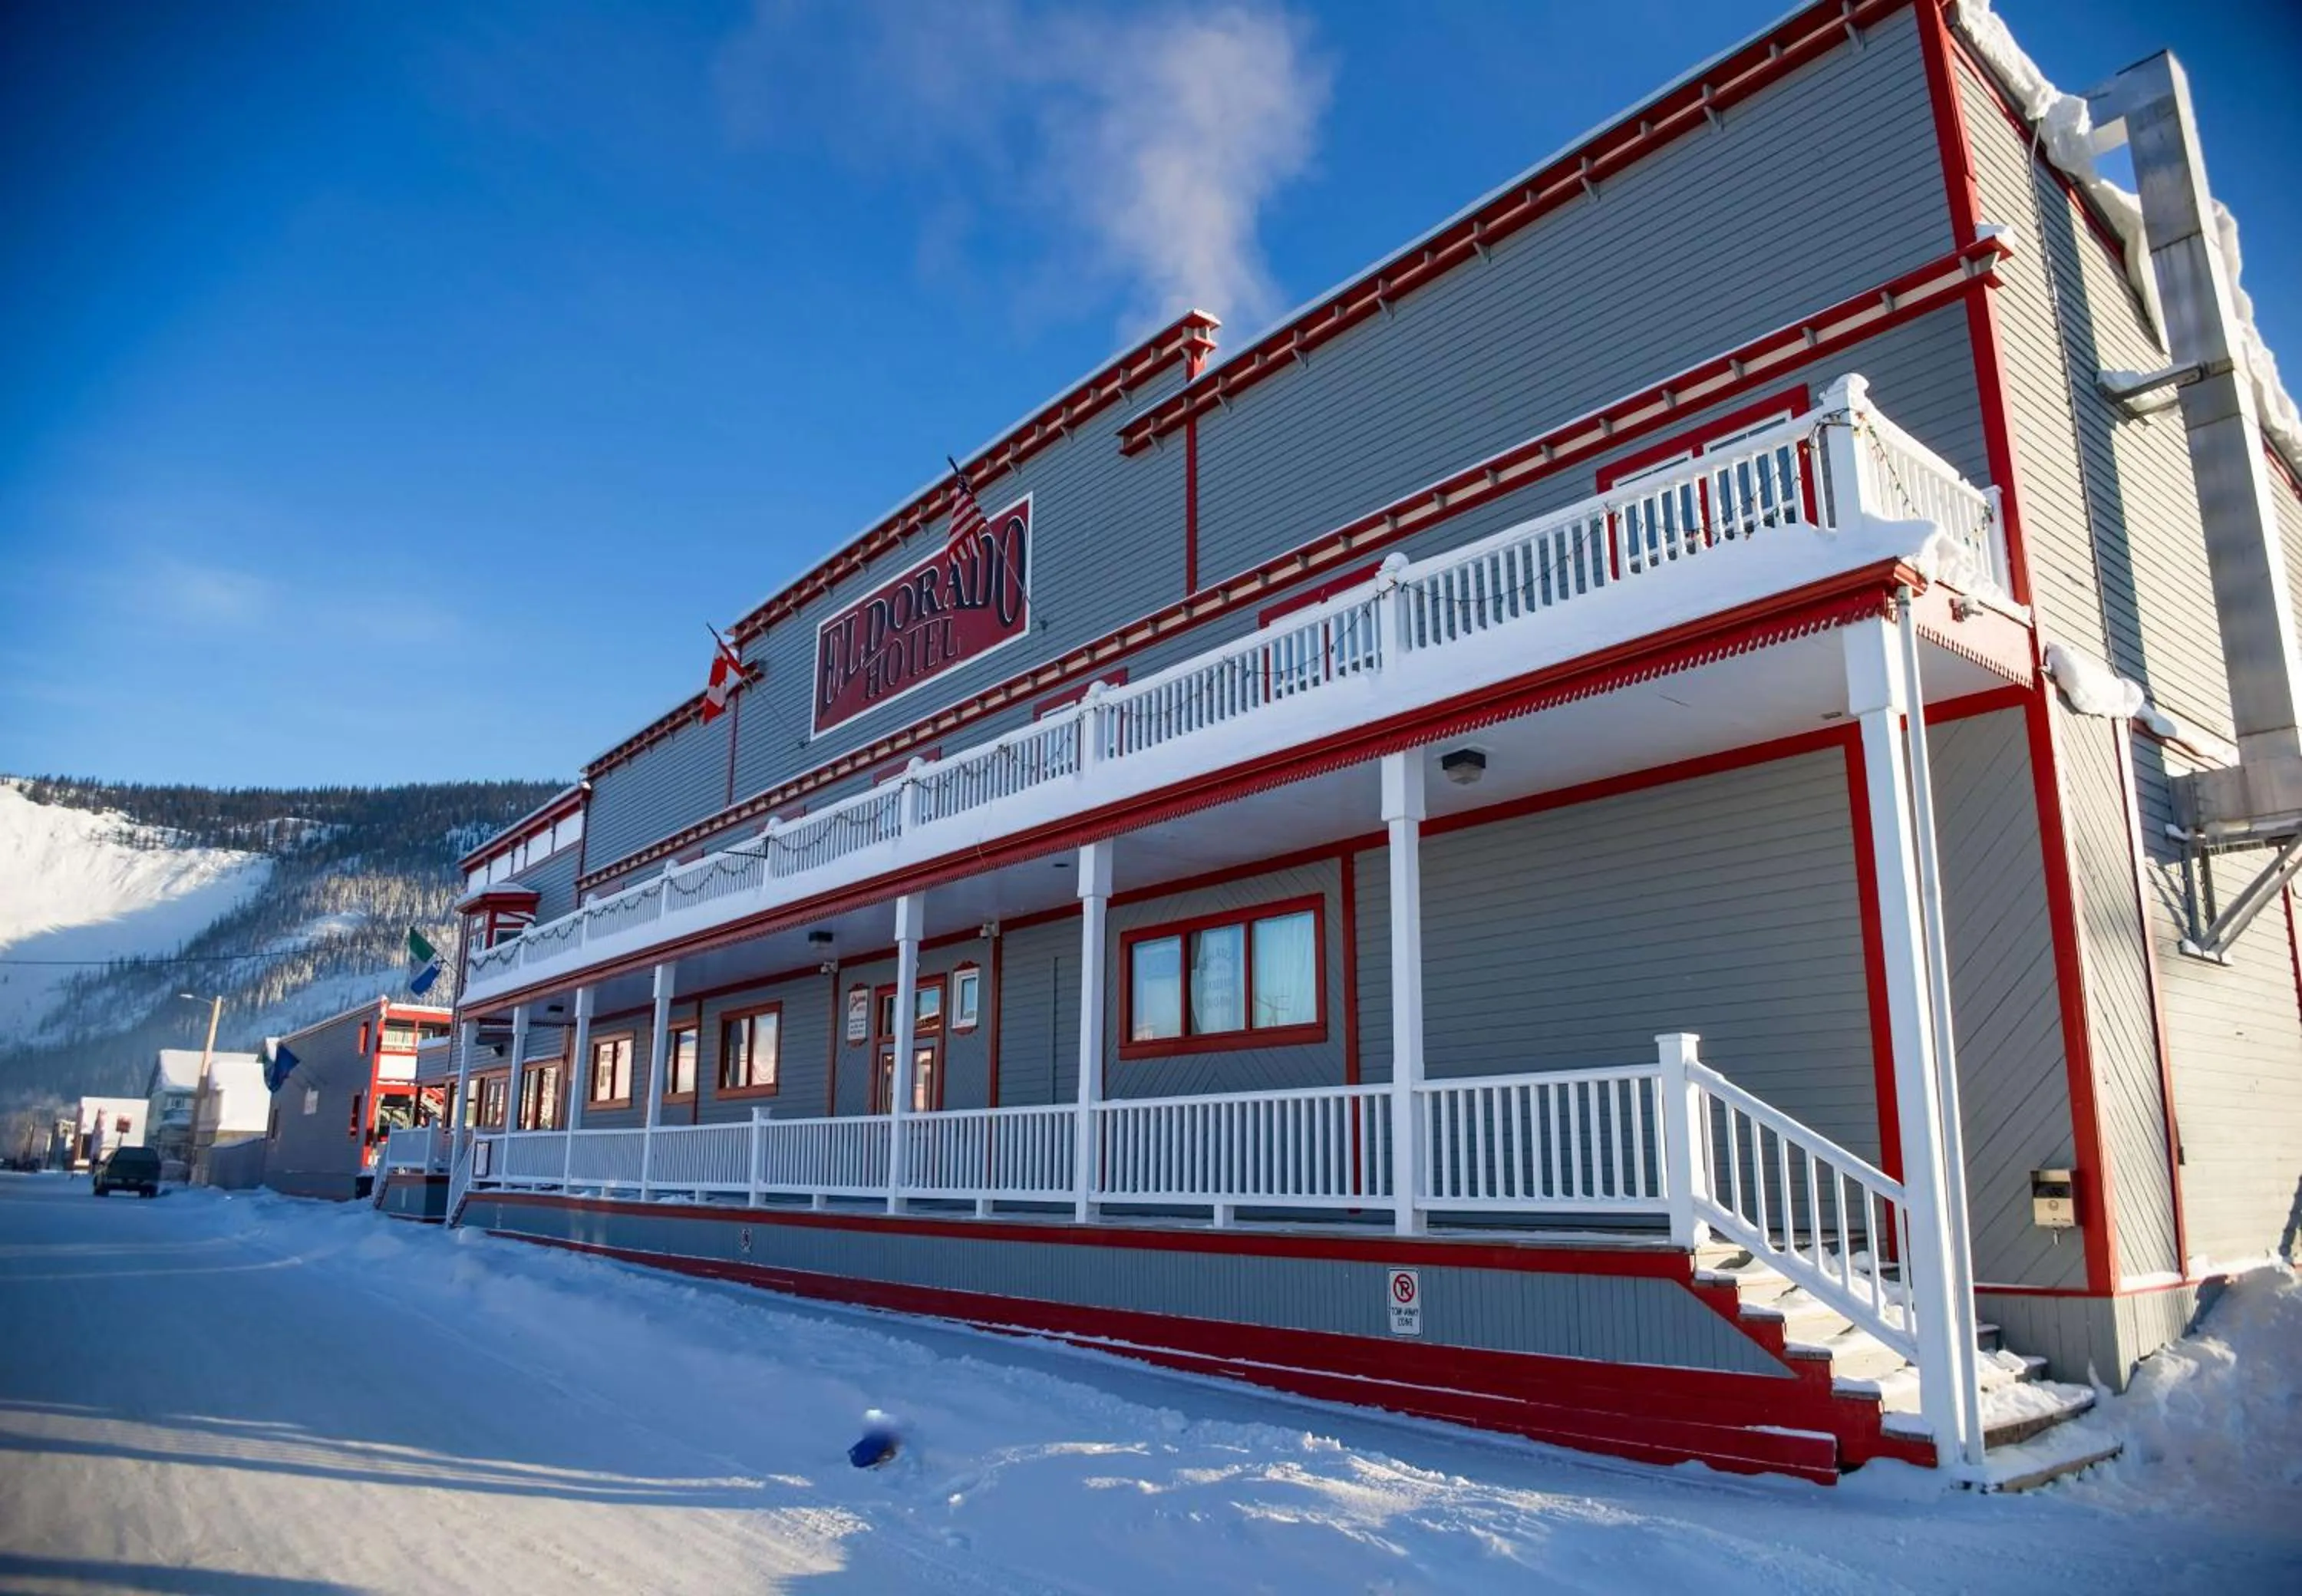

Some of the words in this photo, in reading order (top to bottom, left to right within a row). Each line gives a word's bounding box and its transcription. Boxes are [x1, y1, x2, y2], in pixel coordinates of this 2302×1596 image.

[819, 612, 865, 707] EL
[864, 515, 1027, 661] DORADO
[862, 615, 960, 700] HOTEL
